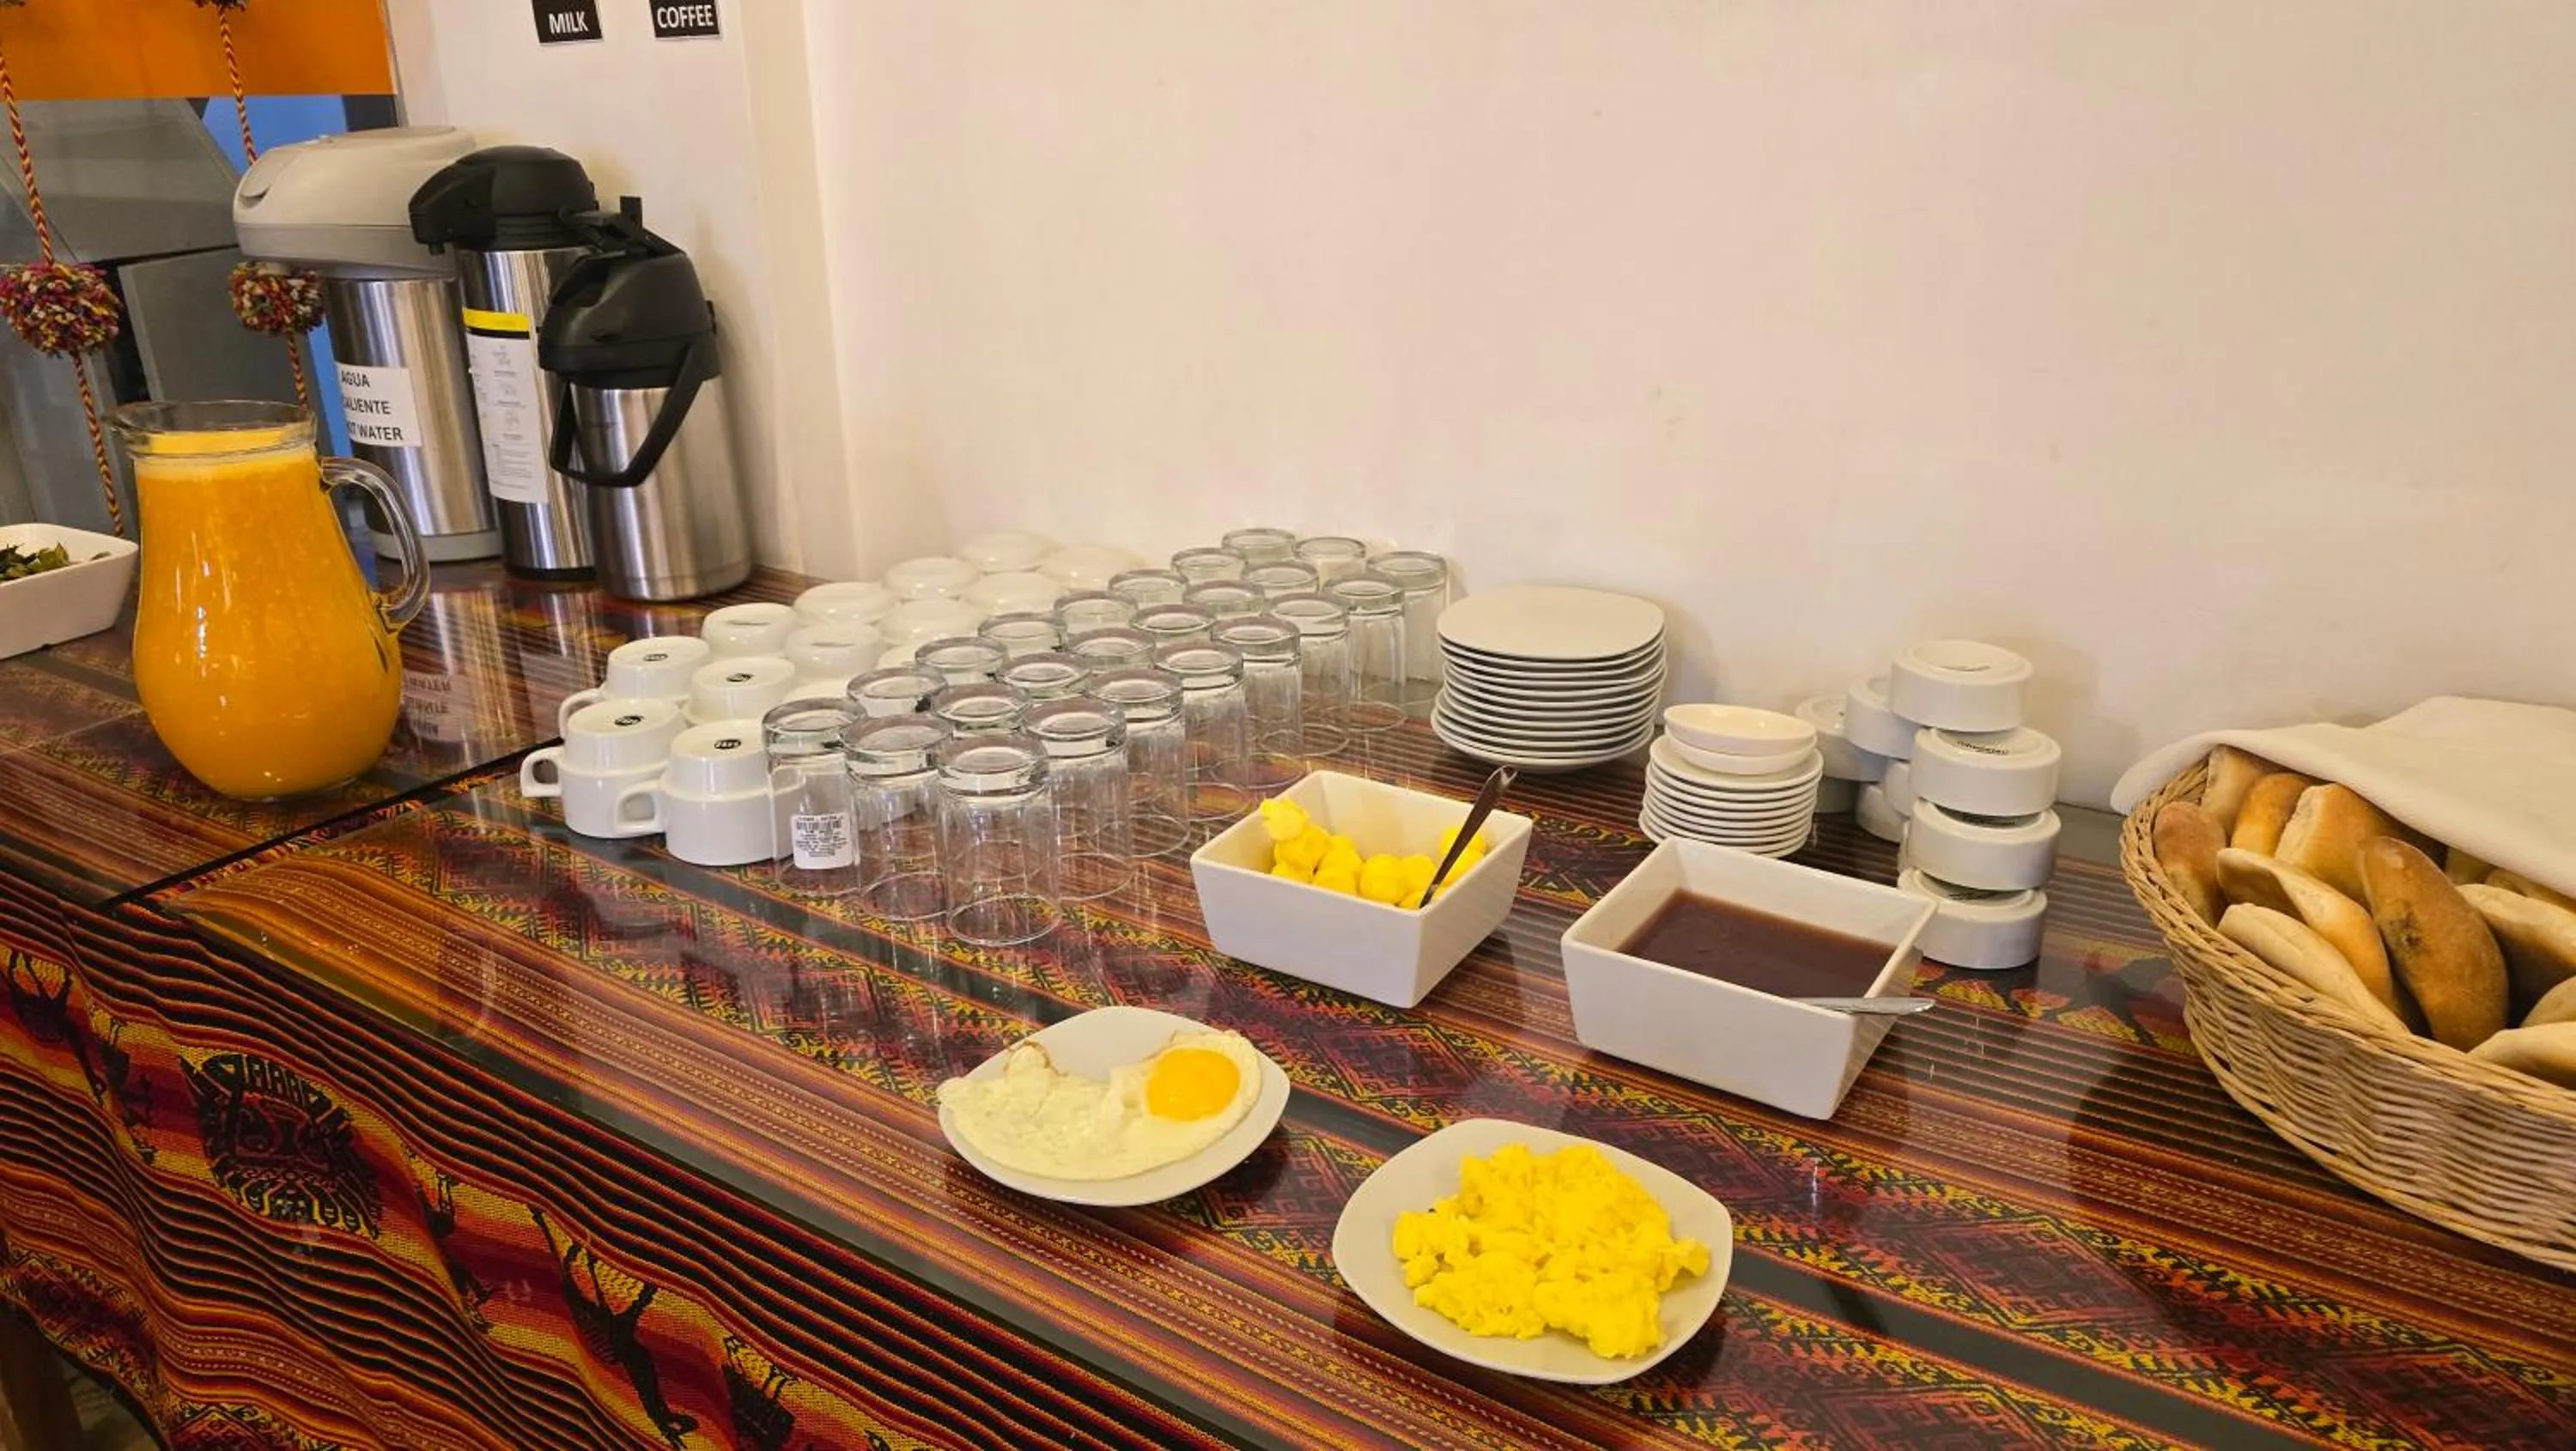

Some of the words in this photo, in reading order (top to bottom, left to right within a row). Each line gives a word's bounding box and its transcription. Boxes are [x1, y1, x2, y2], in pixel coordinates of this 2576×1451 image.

[549, 11, 589, 34] MILK
[657, 4, 714, 28] COFFEE
[341, 370, 370, 387] AGUA
[357, 424, 403, 440] WATER
